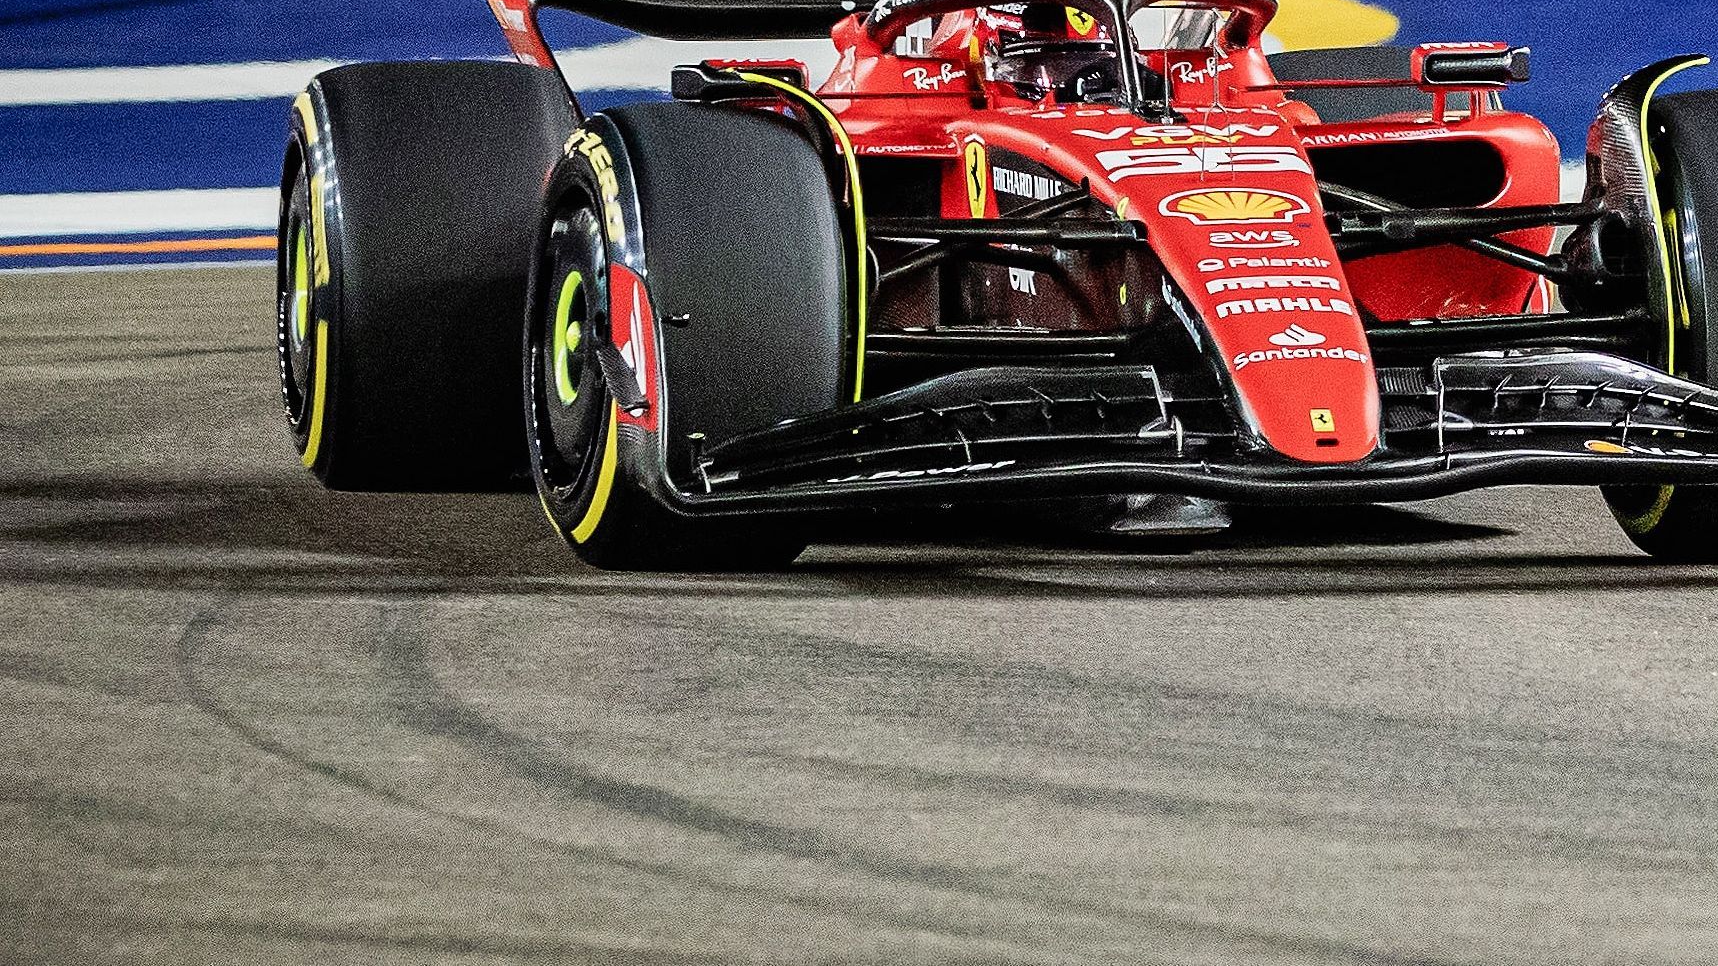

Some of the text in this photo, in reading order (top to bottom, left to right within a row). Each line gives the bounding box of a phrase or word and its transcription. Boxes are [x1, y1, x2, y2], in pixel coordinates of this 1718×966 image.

[1300, 131, 1377, 146] ARMAN
[1095, 146, 1313, 184] 55
[1209, 230, 1300, 249] aws
[1227, 256, 1332, 268] Palantir
[1215, 297, 1354, 319] MAHLE
[1233, 346, 1369, 372] Santander
